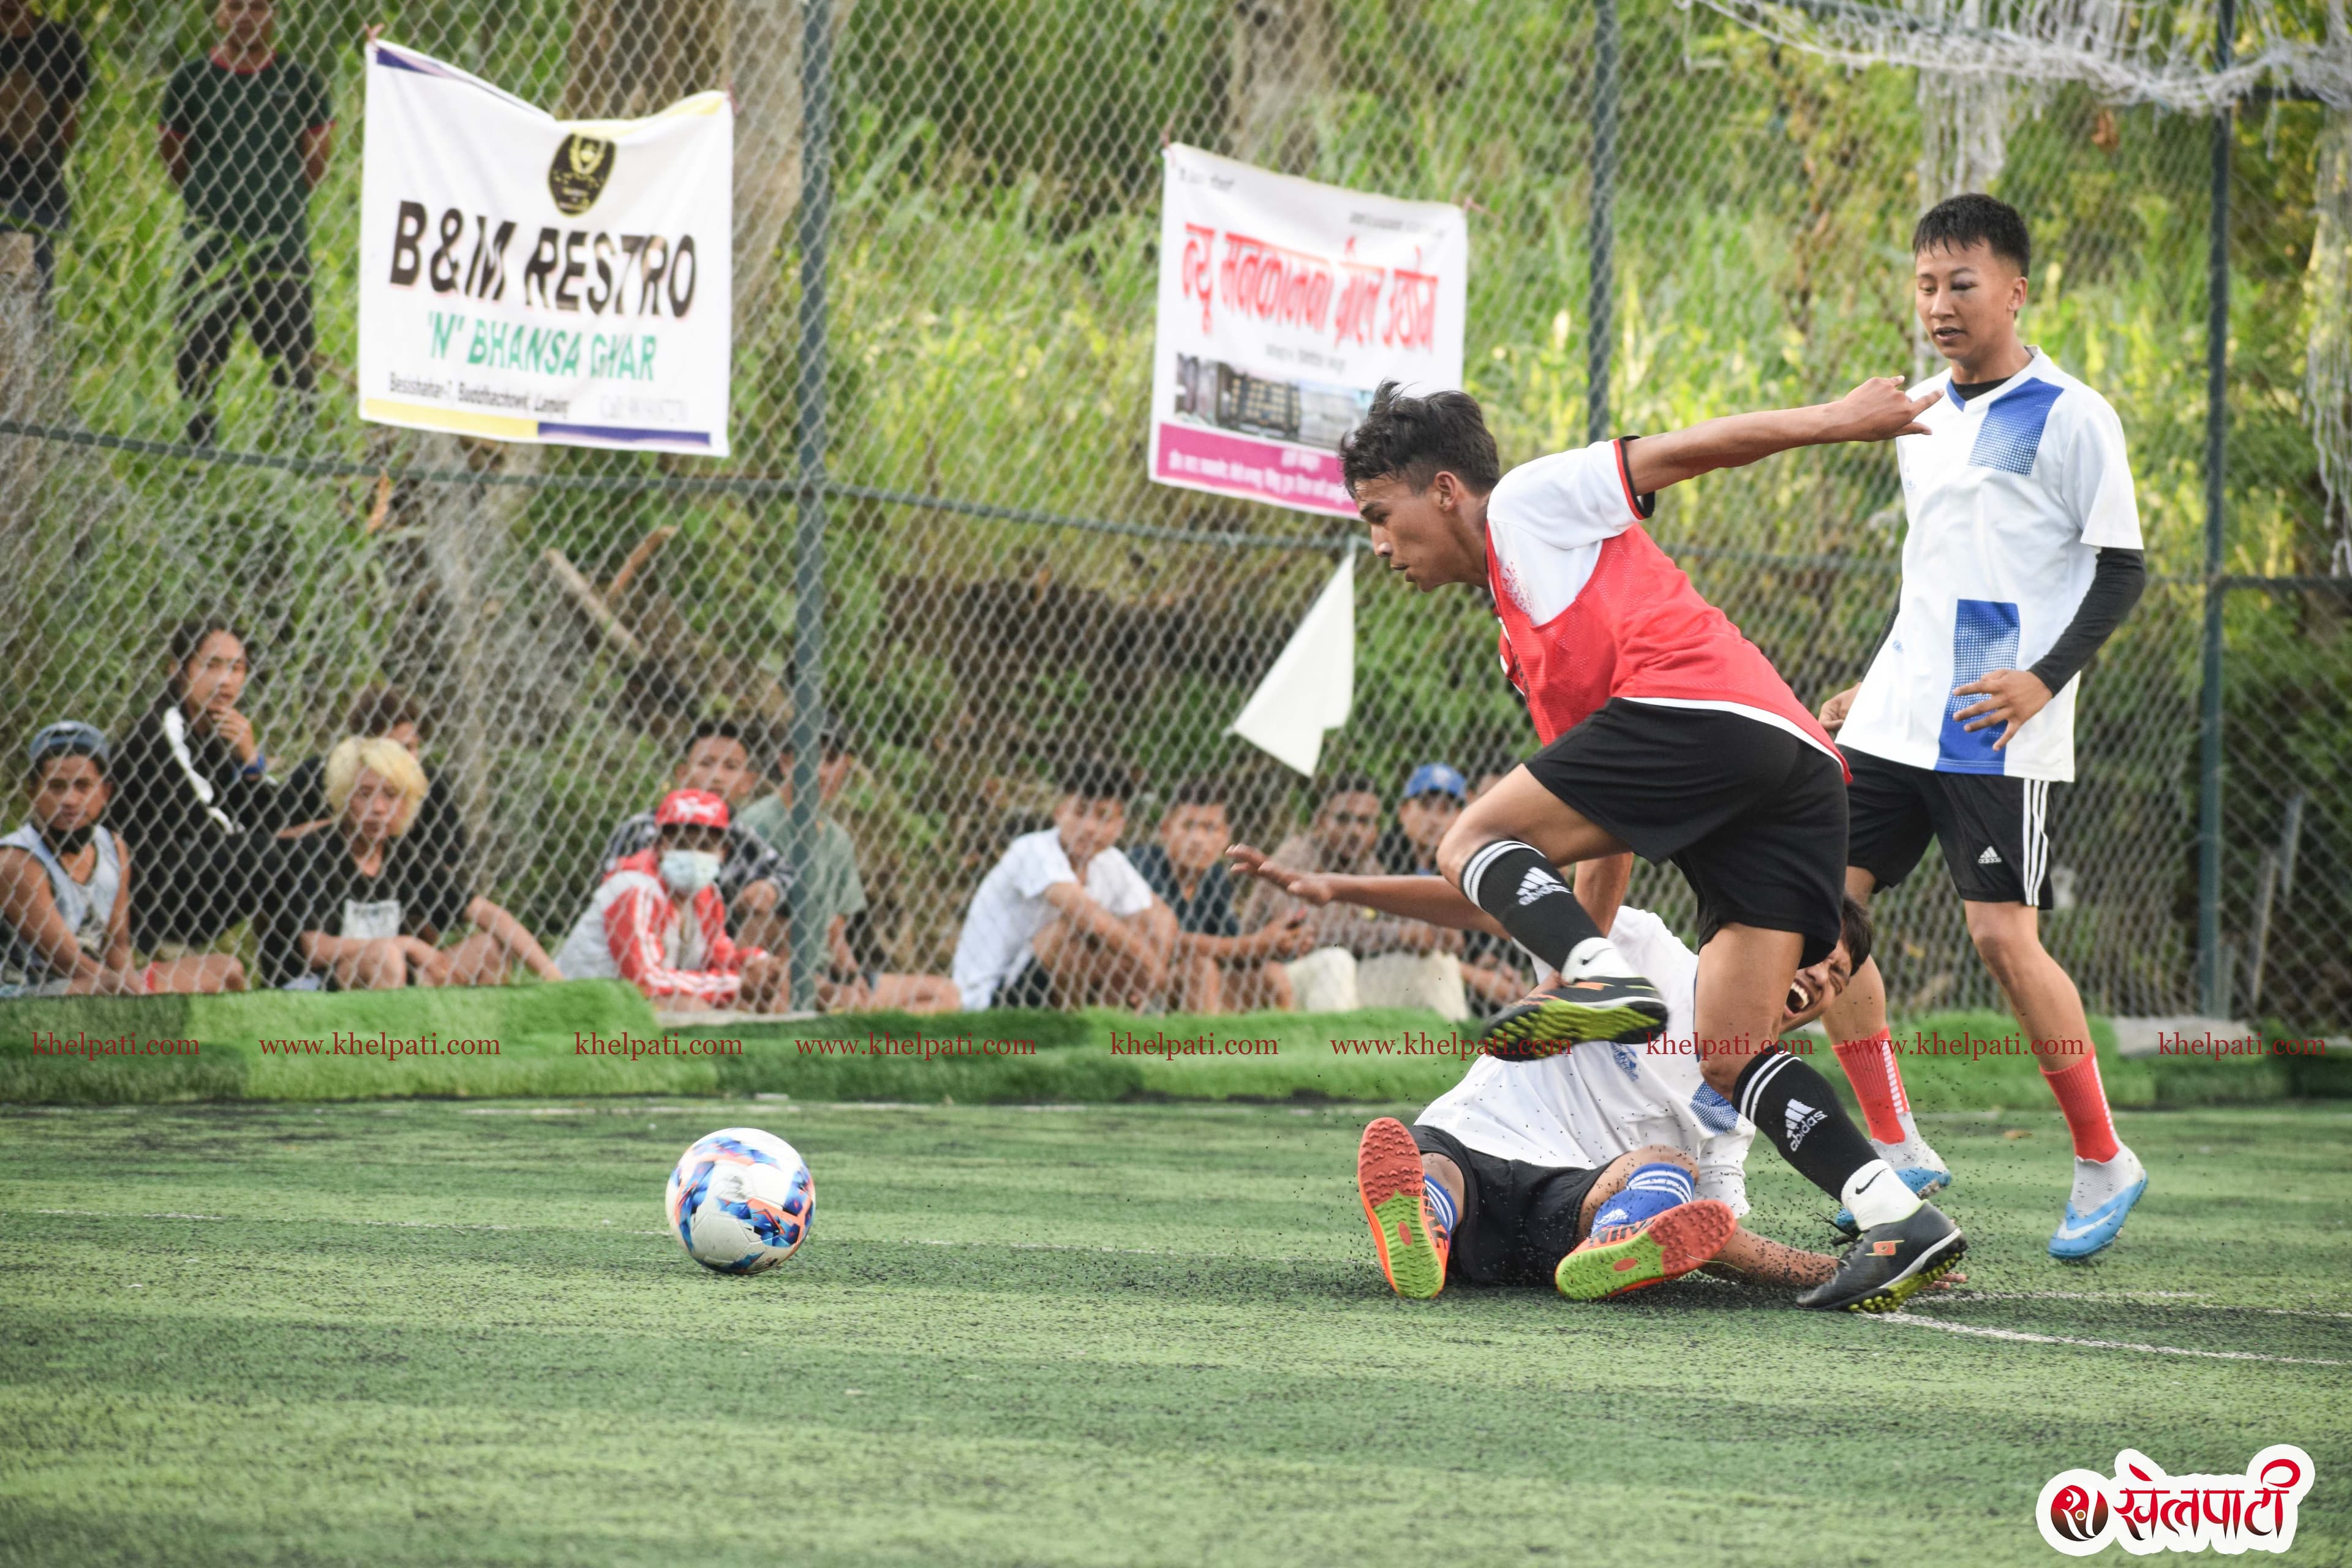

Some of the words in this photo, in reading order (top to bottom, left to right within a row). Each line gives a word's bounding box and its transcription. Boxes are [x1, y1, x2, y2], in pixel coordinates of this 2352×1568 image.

[390, 200, 517, 301] B&M
[524, 227, 697, 319] RESTRO
[466, 319, 582, 379] BHANSA
